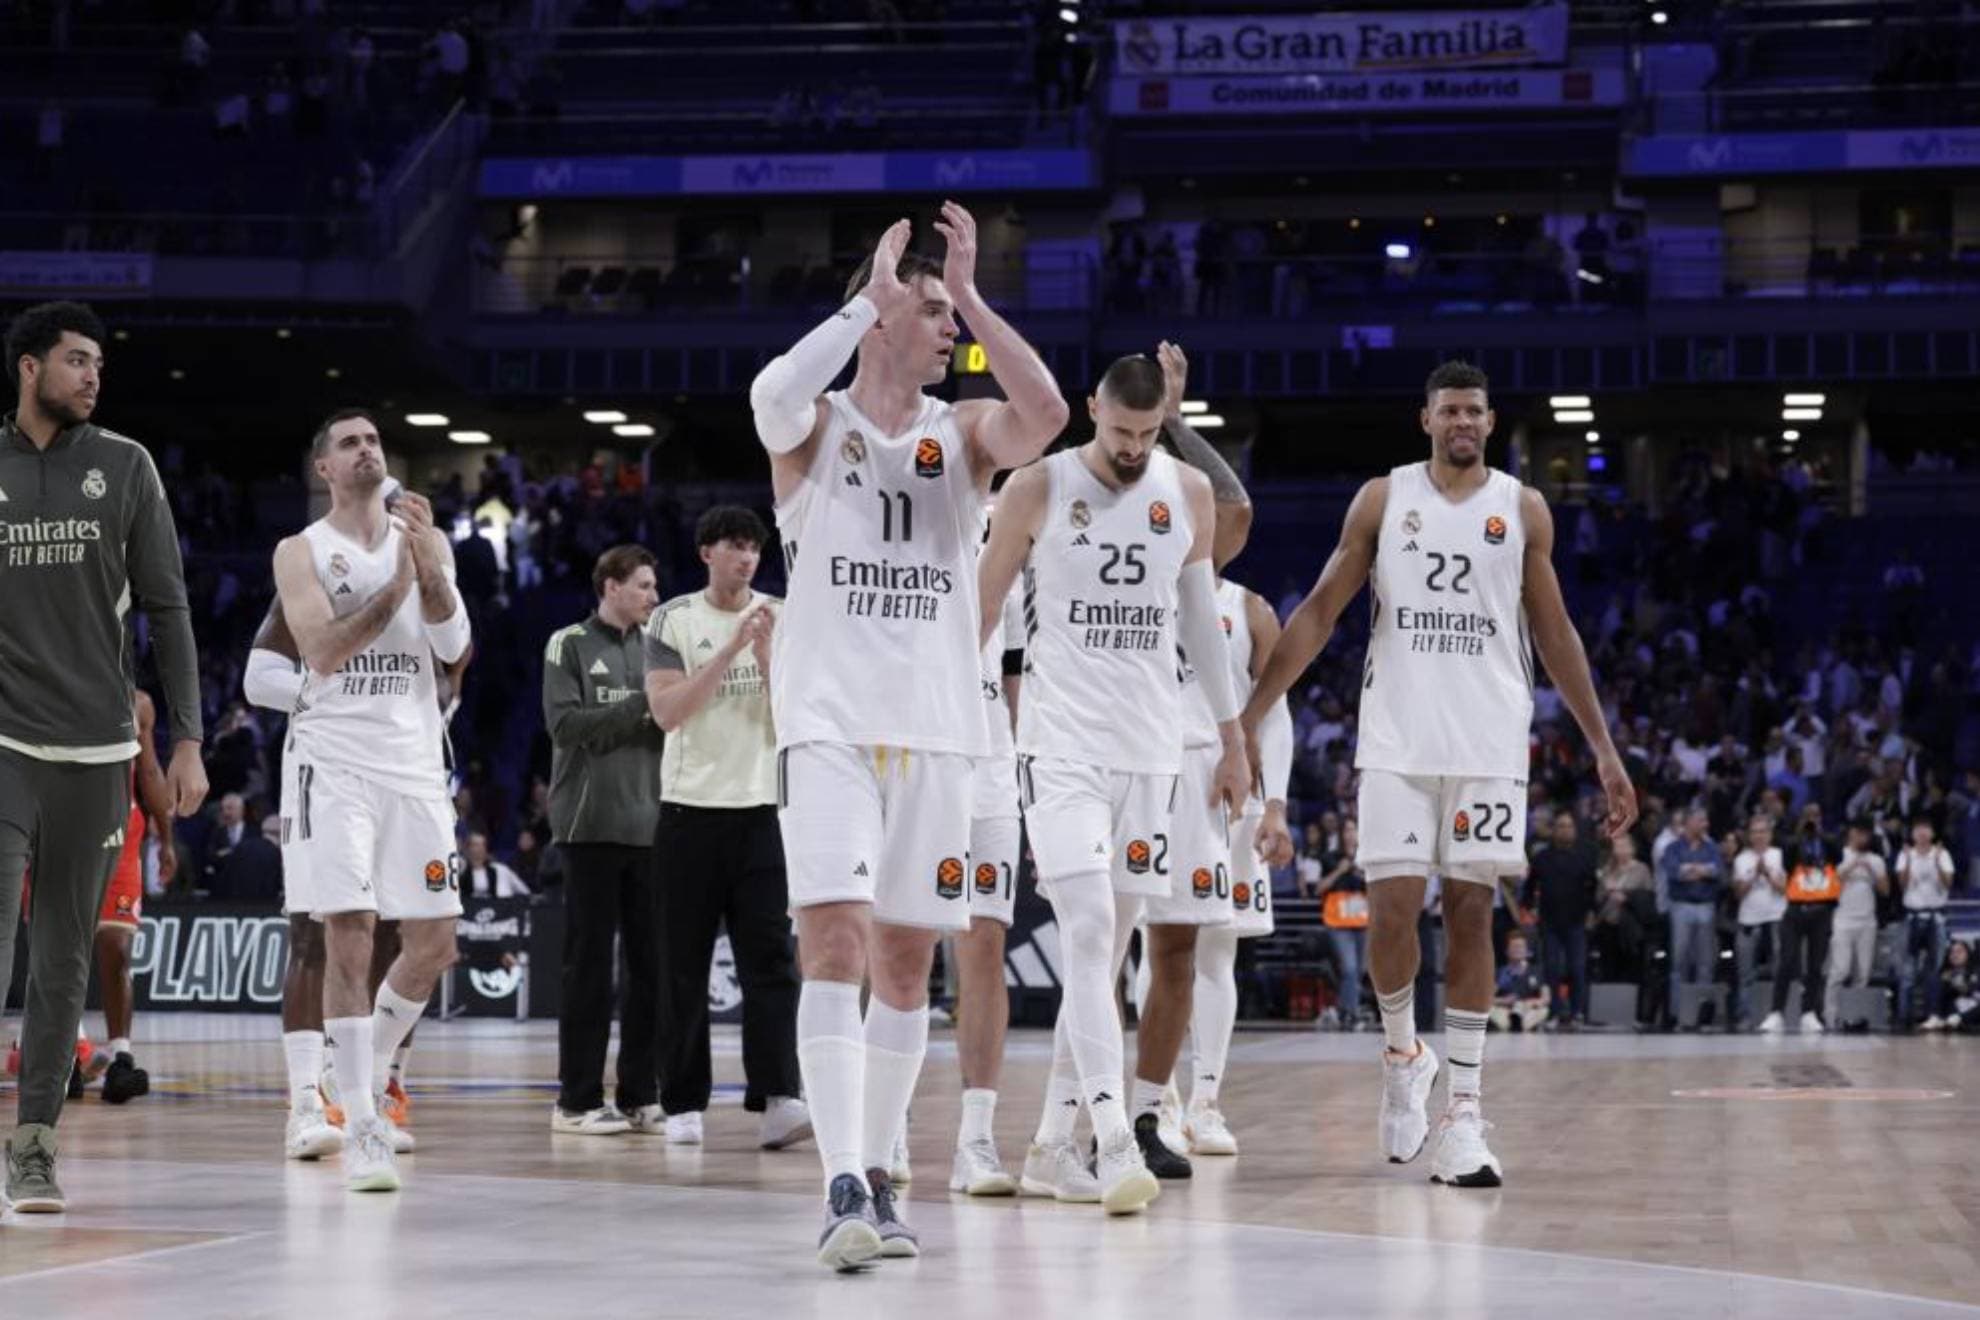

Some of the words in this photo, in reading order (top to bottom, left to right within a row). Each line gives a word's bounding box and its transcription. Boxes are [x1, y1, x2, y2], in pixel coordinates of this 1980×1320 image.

[1173, 25, 1224, 61] La
[1233, 24, 1345, 60] Gran
[1357, 20, 1525, 58] Familia
[1212, 80, 1369, 104] Comunidad
[1378, 79, 1411, 99] de
[1422, 78, 1520, 99] Madrid
[878, 489, 912, 541] 11
[9, 545, 33, 567] FLY
[37, 542, 85, 565] BETTER
[1099, 543, 1147, 585] 25
[831, 556, 952, 594] Emirates
[1426, 552, 1471, 594] 22
[847, 591, 877, 616] FLY
[881, 594, 939, 621] BETTER
[1397, 606, 1497, 637] Emirates
[1085, 628, 1110, 649] FLY
[1112, 630, 1160, 651] BETTER
[1411, 633, 1436, 653] FLY
[1437, 634, 1484, 656] BETTER
[342, 676, 367, 695] FLY
[1473, 803, 1513, 842] 22
[1254, 879, 1267, 913] 8
